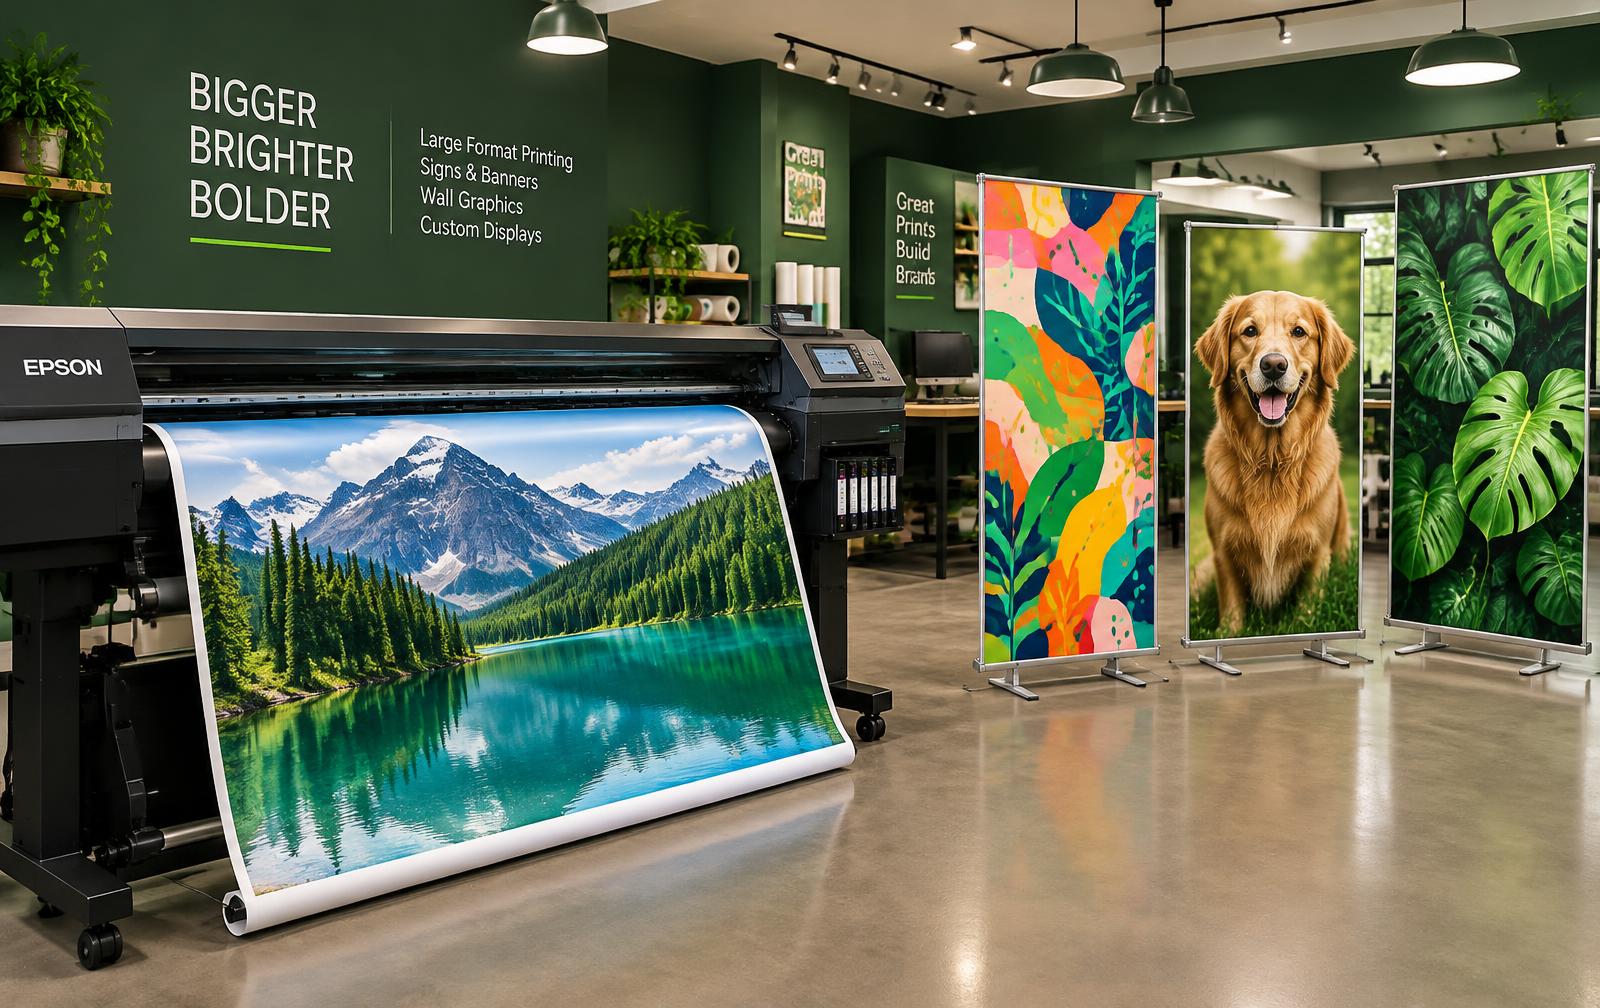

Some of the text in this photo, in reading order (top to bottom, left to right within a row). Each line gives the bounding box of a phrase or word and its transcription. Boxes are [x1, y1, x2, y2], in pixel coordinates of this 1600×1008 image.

[190, 71, 317, 129] BIGGER
[190, 124, 354, 183] BRIGHTER
[420, 127, 573, 174] Large Format Printing
[420, 156, 539, 190] Signs & Banners
[190, 179, 331, 230] BOLDER
[420, 185, 524, 216] Wall Graphics
[896, 191, 935, 214] Great
[420, 215, 542, 247] Custom Displays
[896, 214, 936, 239] Prints
[23, 358, 103, 376] EPSON
